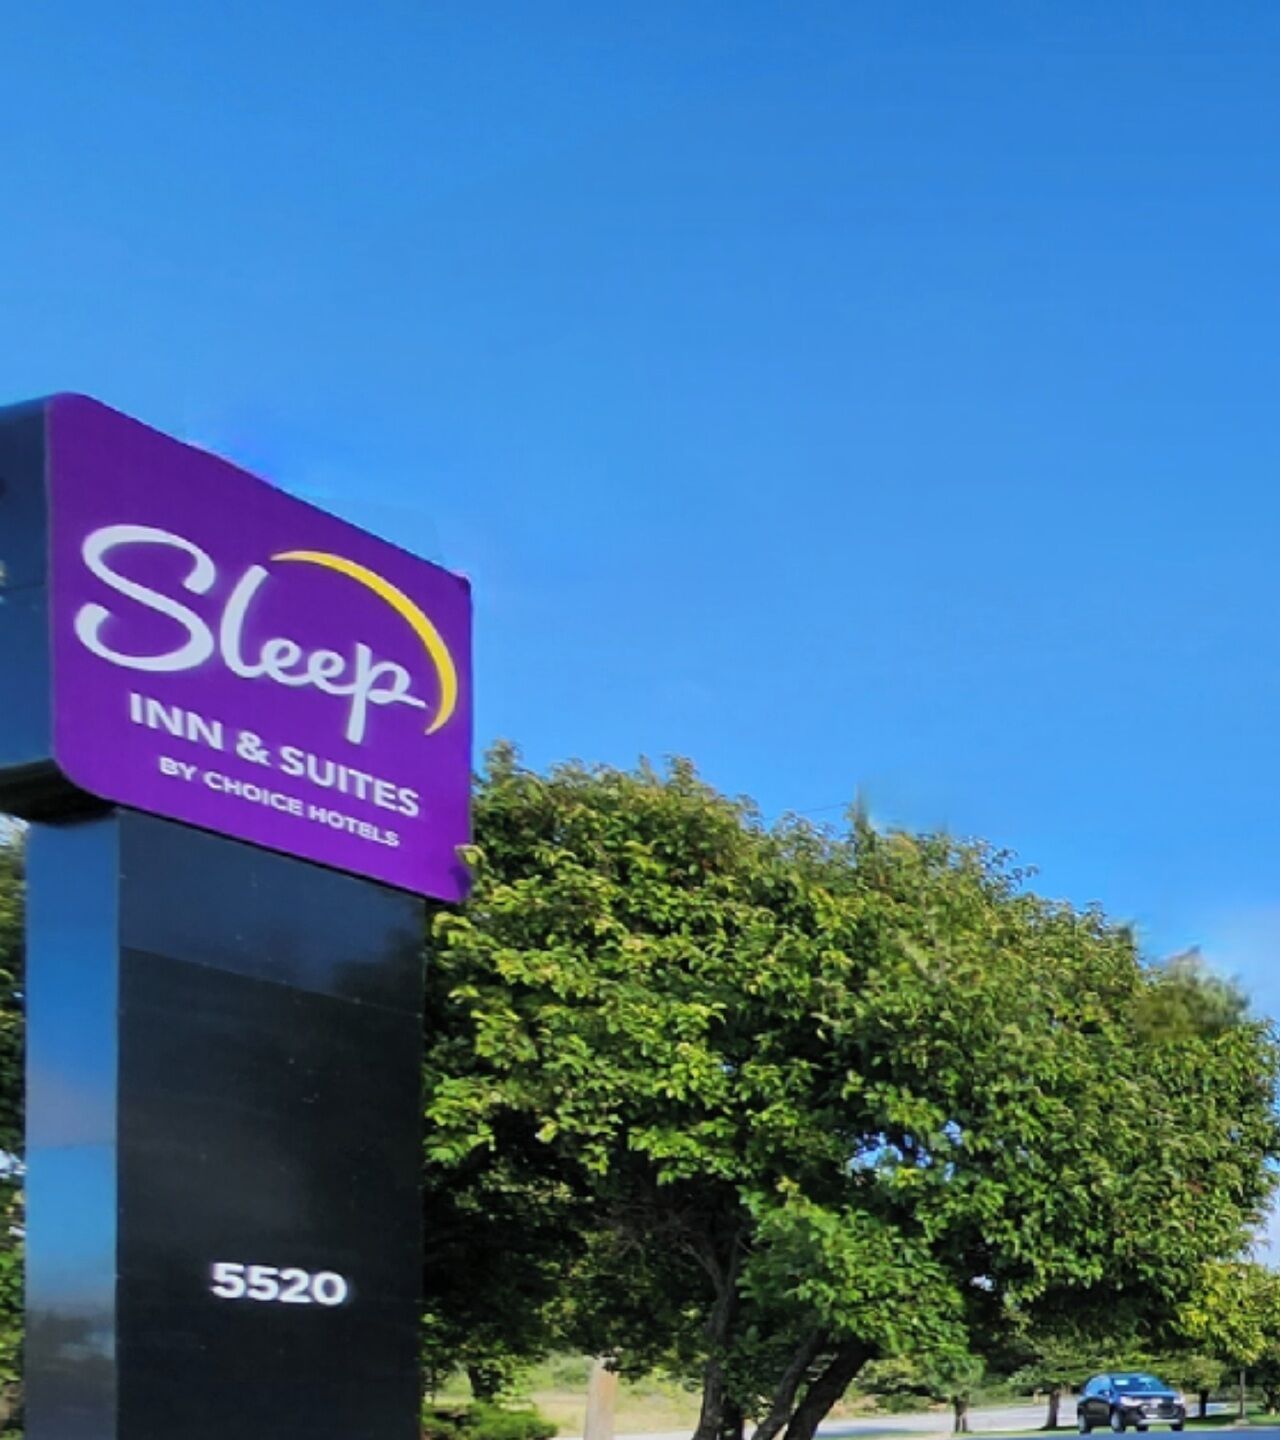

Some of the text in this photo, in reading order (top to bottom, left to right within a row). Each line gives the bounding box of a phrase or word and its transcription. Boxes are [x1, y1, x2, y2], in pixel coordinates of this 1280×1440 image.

[74, 524, 429, 745] Sleep
[130, 692, 421, 818] INN & SUITES
[158, 756, 400, 848] BY CHOICE HOTELS
[211, 1261, 348, 1306] 5520
